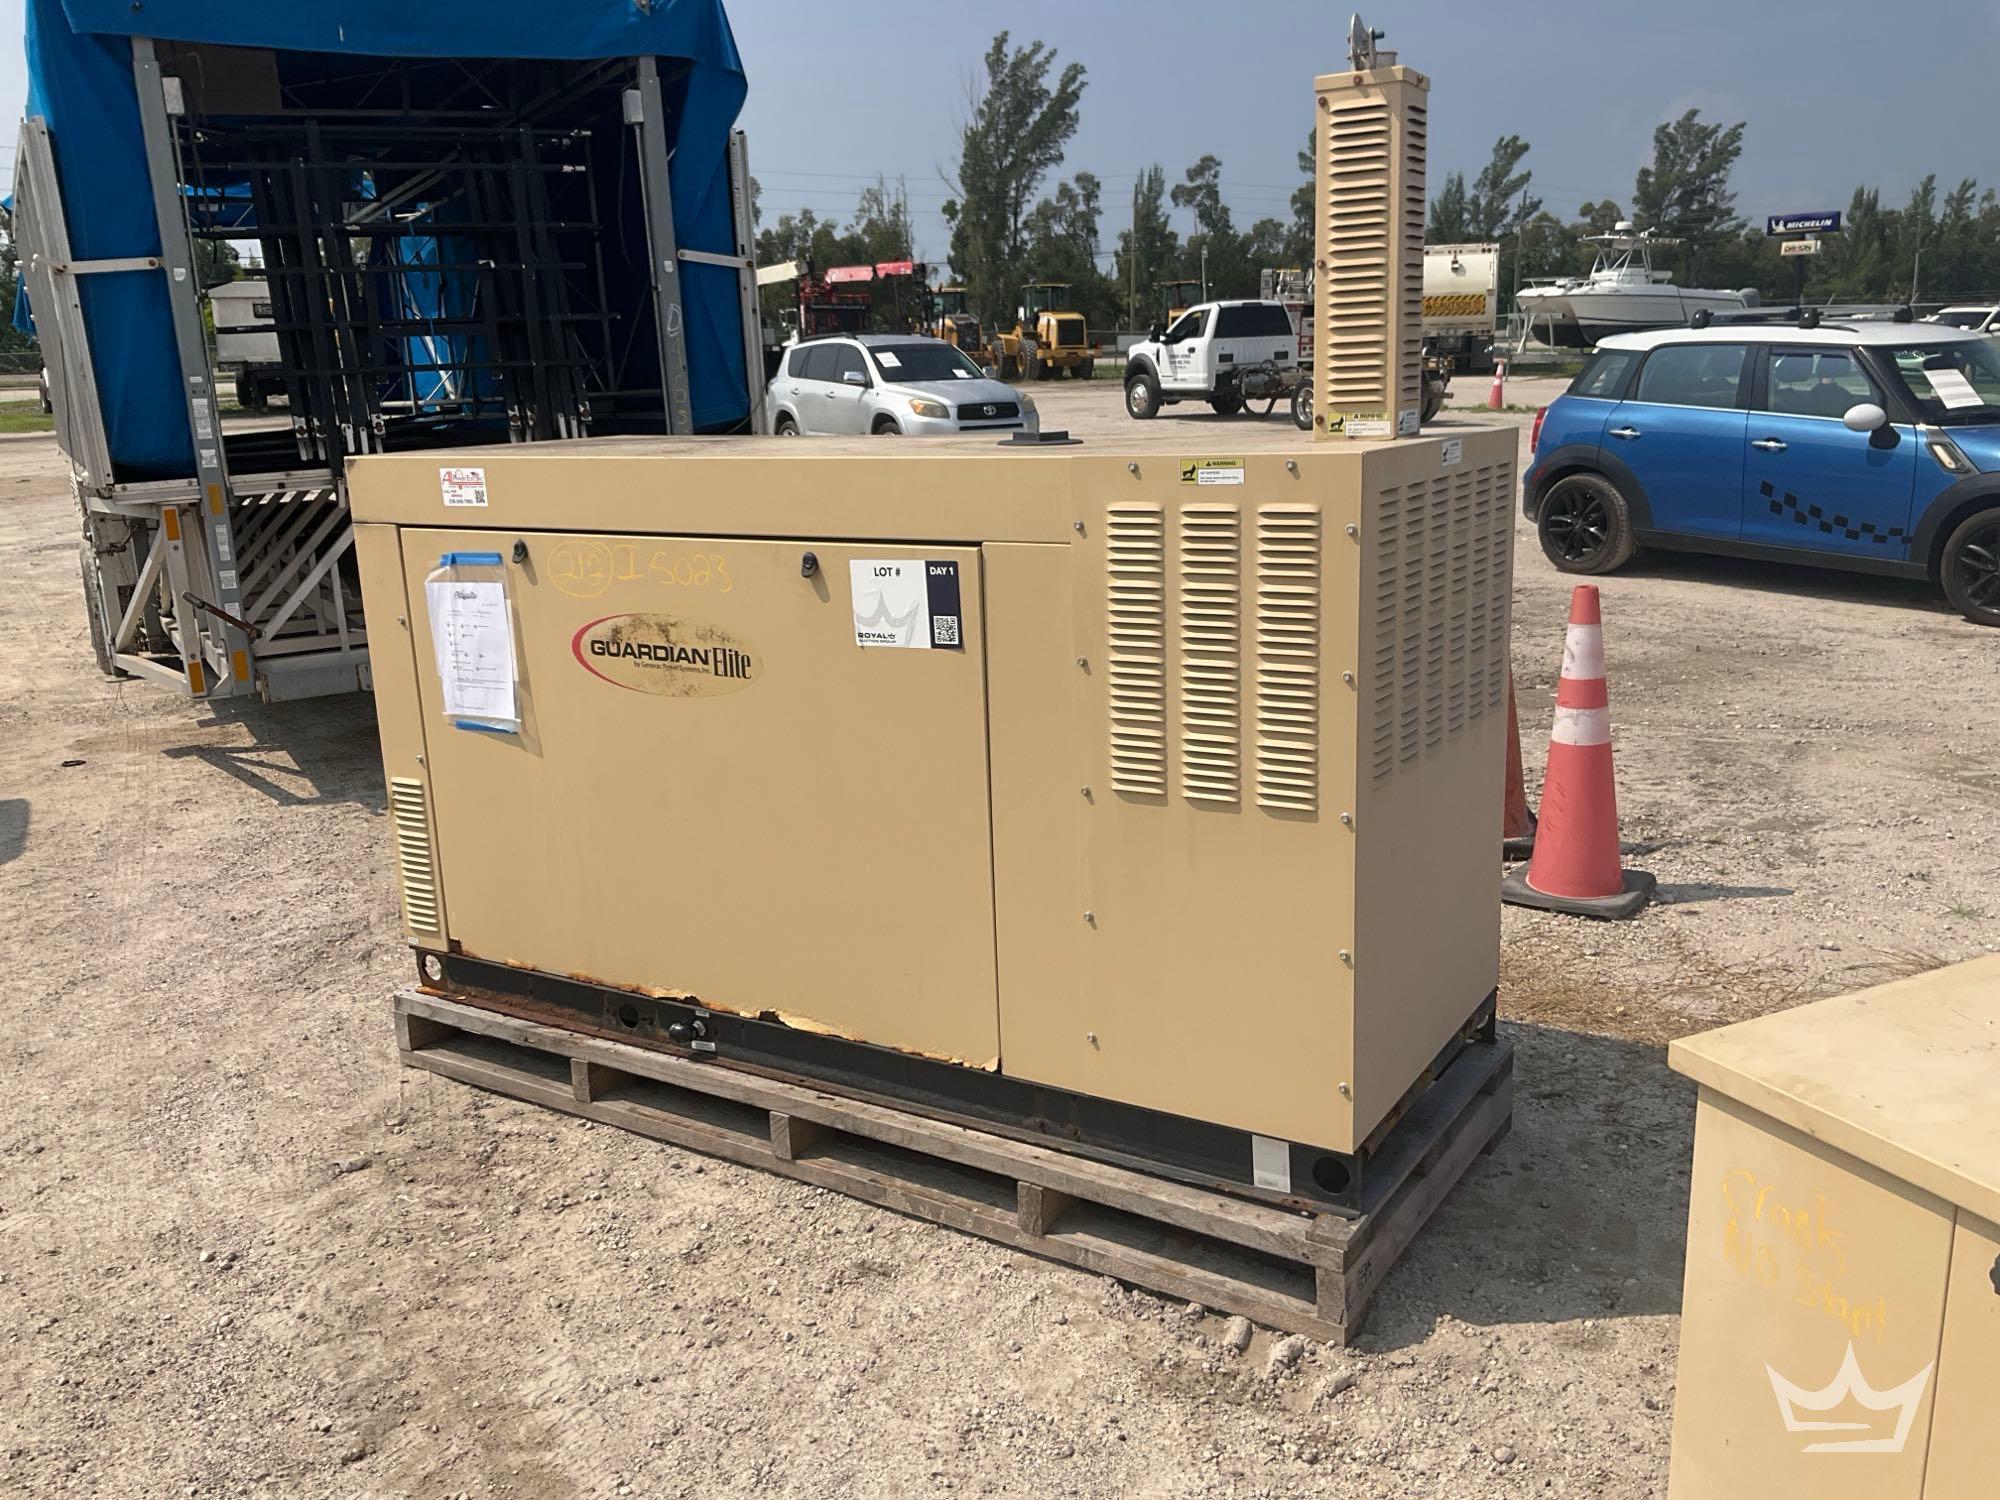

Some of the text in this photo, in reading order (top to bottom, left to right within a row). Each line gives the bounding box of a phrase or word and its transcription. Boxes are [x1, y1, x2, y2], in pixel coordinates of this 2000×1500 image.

[1786, 218, 1833, 229] MICHELIN
[1432, 300, 1472, 310] CAUTION
[873, 566, 901, 577] LOT #
[929, 566, 954, 576] DAY 1
[857, 632, 889, 640] ROYAL
[590, 639, 709, 666] GUARDIAN
[712, 647, 752, 680] Elite
